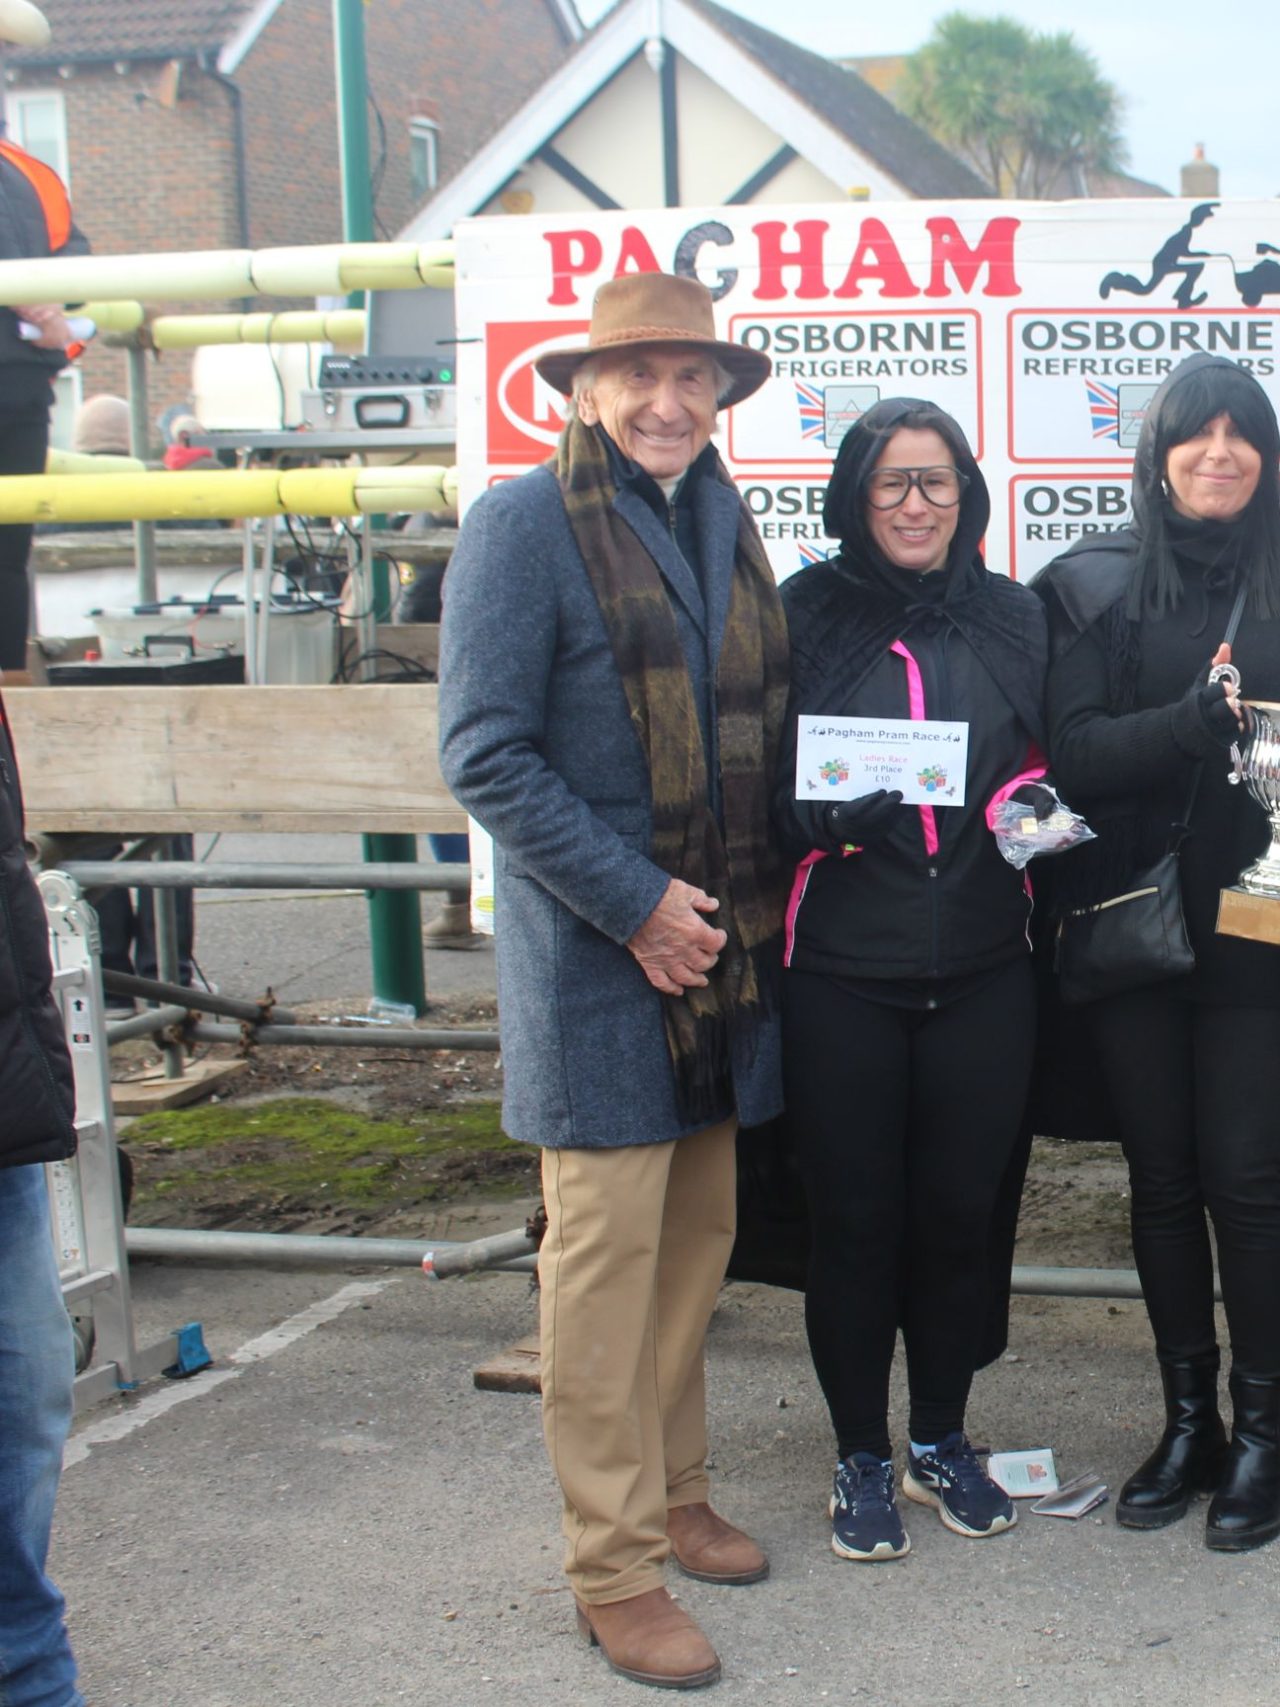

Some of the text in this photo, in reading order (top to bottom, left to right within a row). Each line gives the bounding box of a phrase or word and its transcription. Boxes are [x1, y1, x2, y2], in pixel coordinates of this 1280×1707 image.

[543, 216, 1022, 306] PAGHAM
[740, 321, 967, 354] OSBORNE
[1021, 320, 1274, 352] OSBORNE
[769, 358, 968, 378] FRIGERATORS
[1023, 357, 1275, 376] REFRIGERRS
[827, 727, 941, 741] Pagham Pram Race
[859, 754, 908, 763] Ladies Race
